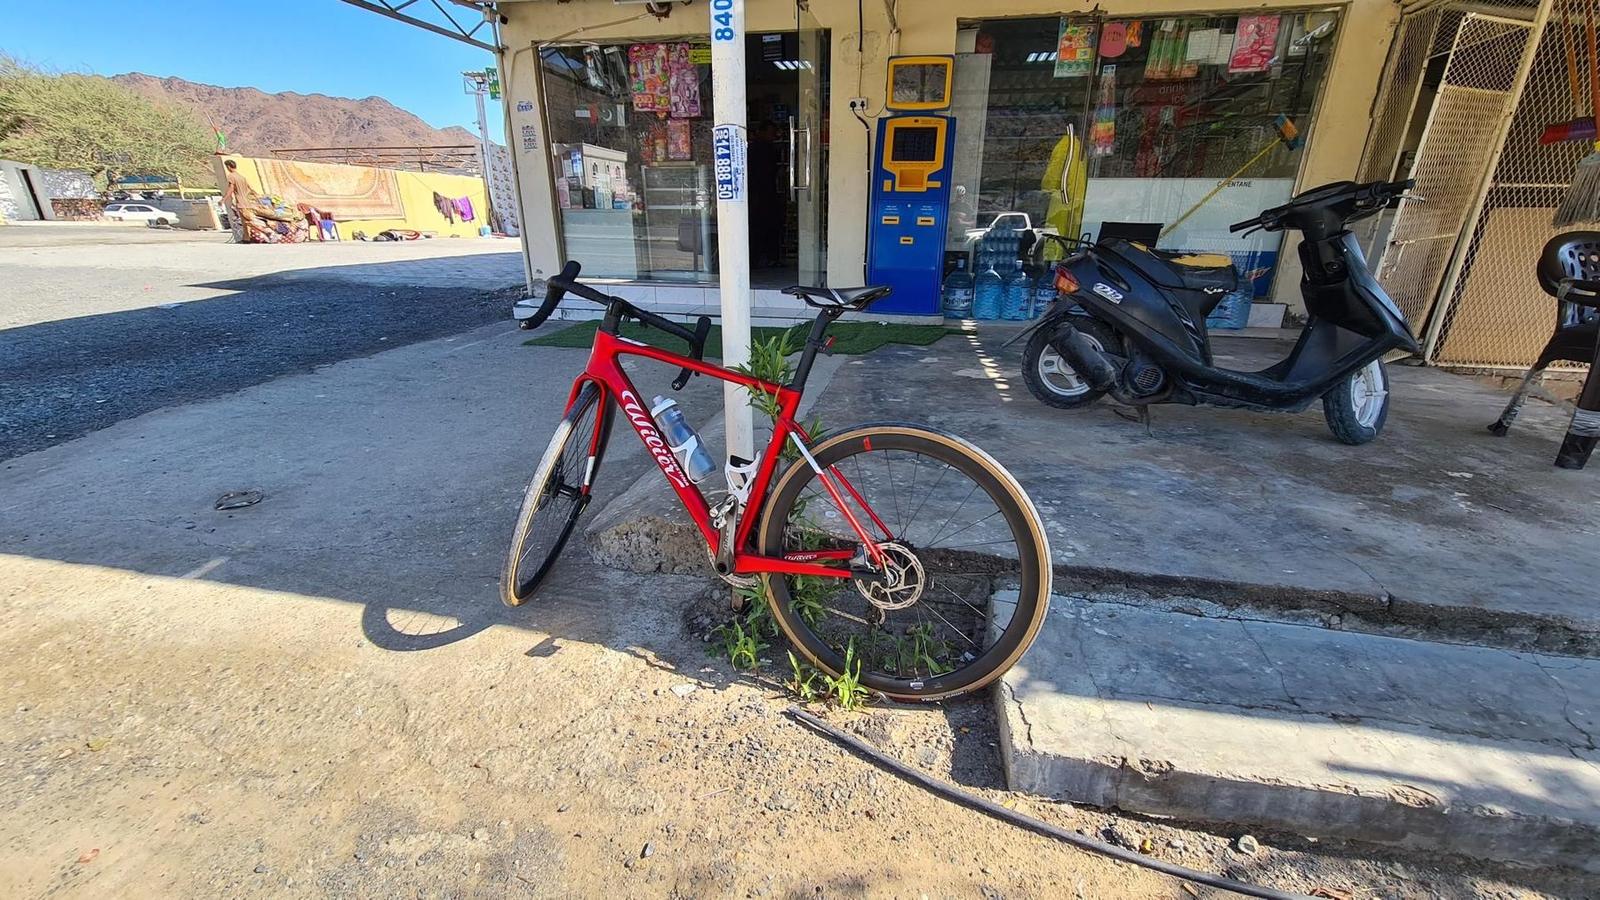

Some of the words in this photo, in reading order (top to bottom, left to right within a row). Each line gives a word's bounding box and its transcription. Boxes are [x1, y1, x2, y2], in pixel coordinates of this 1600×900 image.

[714, 0, 733, 40] 840
[716, 139, 730, 156] 14
[717, 158, 731, 181] 888
[719, 183, 733, 199] 50
[622, 390, 686, 488] Wilier
